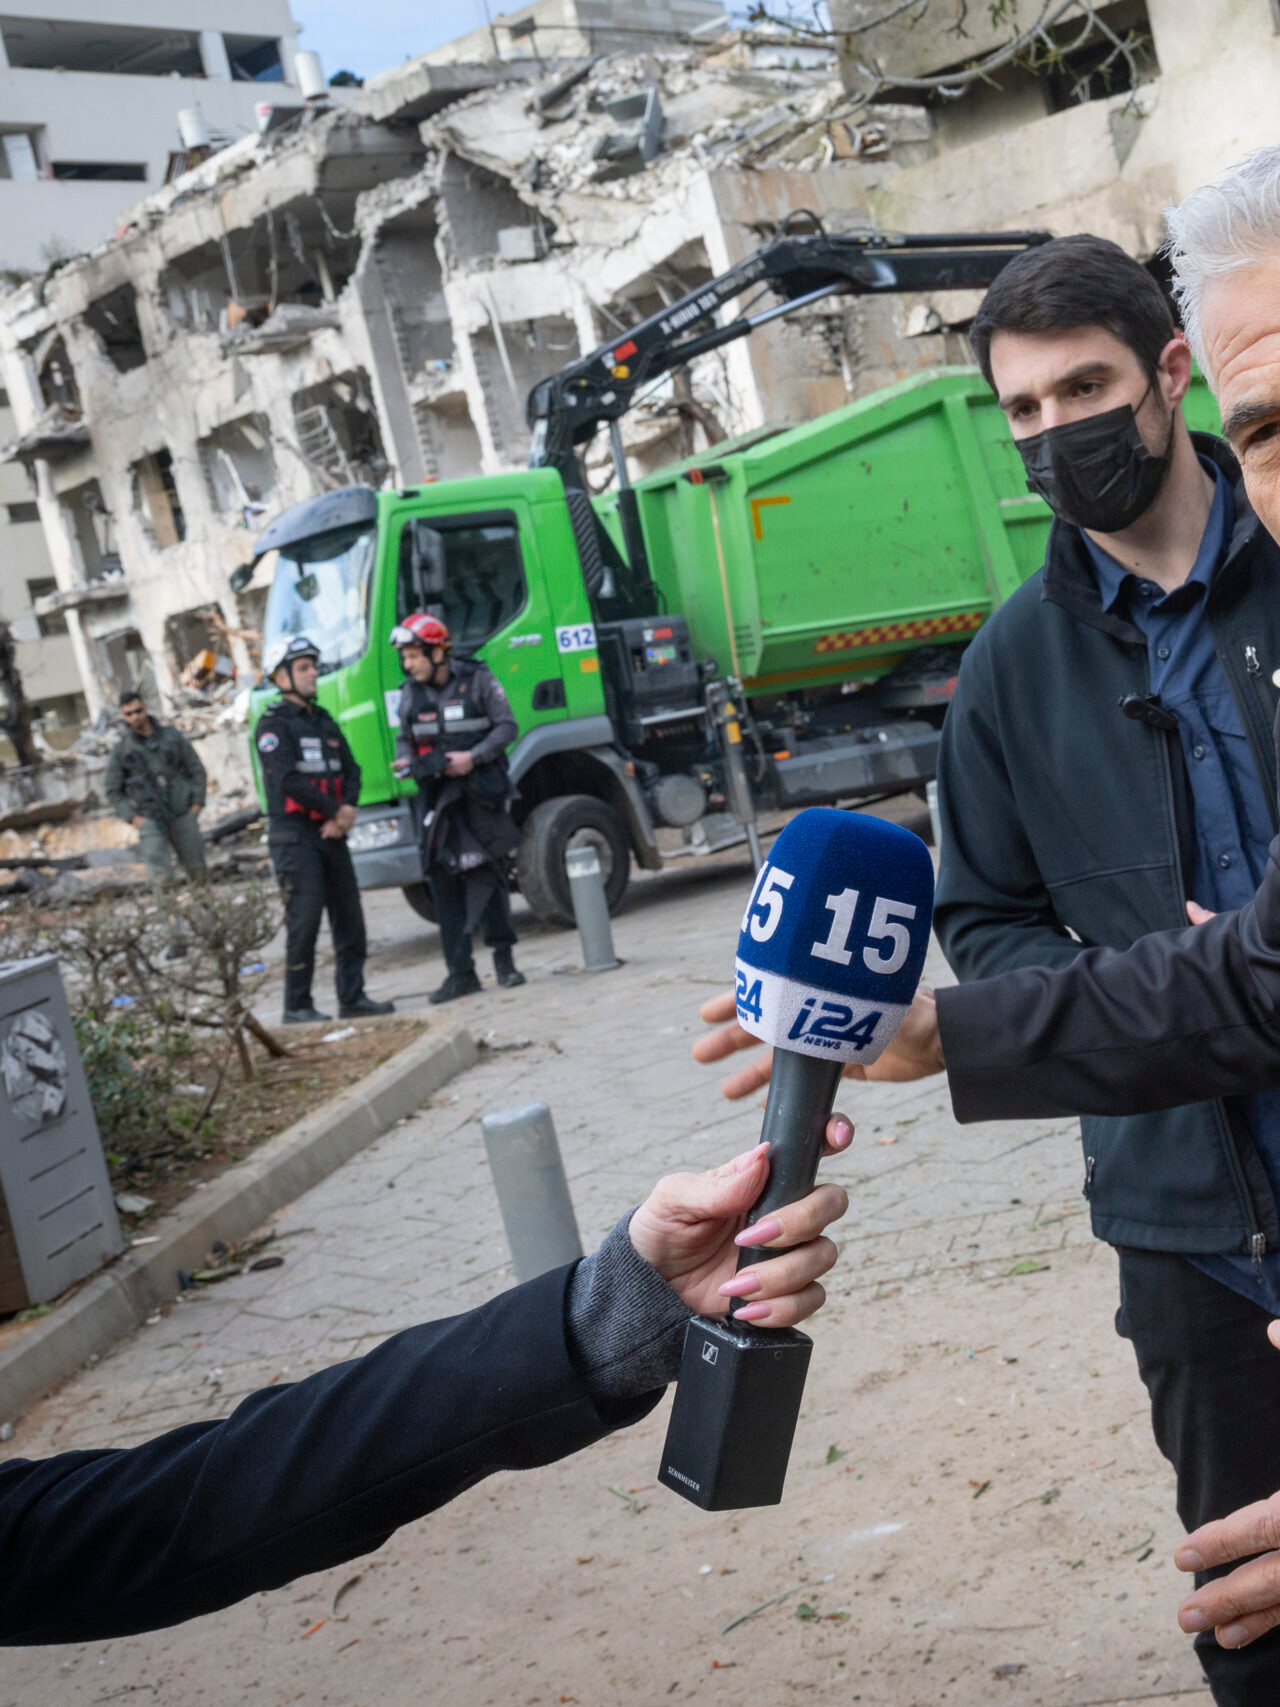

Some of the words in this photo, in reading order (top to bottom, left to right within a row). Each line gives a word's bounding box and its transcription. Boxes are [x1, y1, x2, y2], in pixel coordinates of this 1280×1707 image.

[560, 628, 593, 648] 612
[810, 887, 917, 975] 15
[736, 968, 763, 1023] 24
[788, 998, 883, 1051] i24
[803, 1035, 842, 1050] NEWS
[668, 1466, 700, 1491] SENNHEISER
